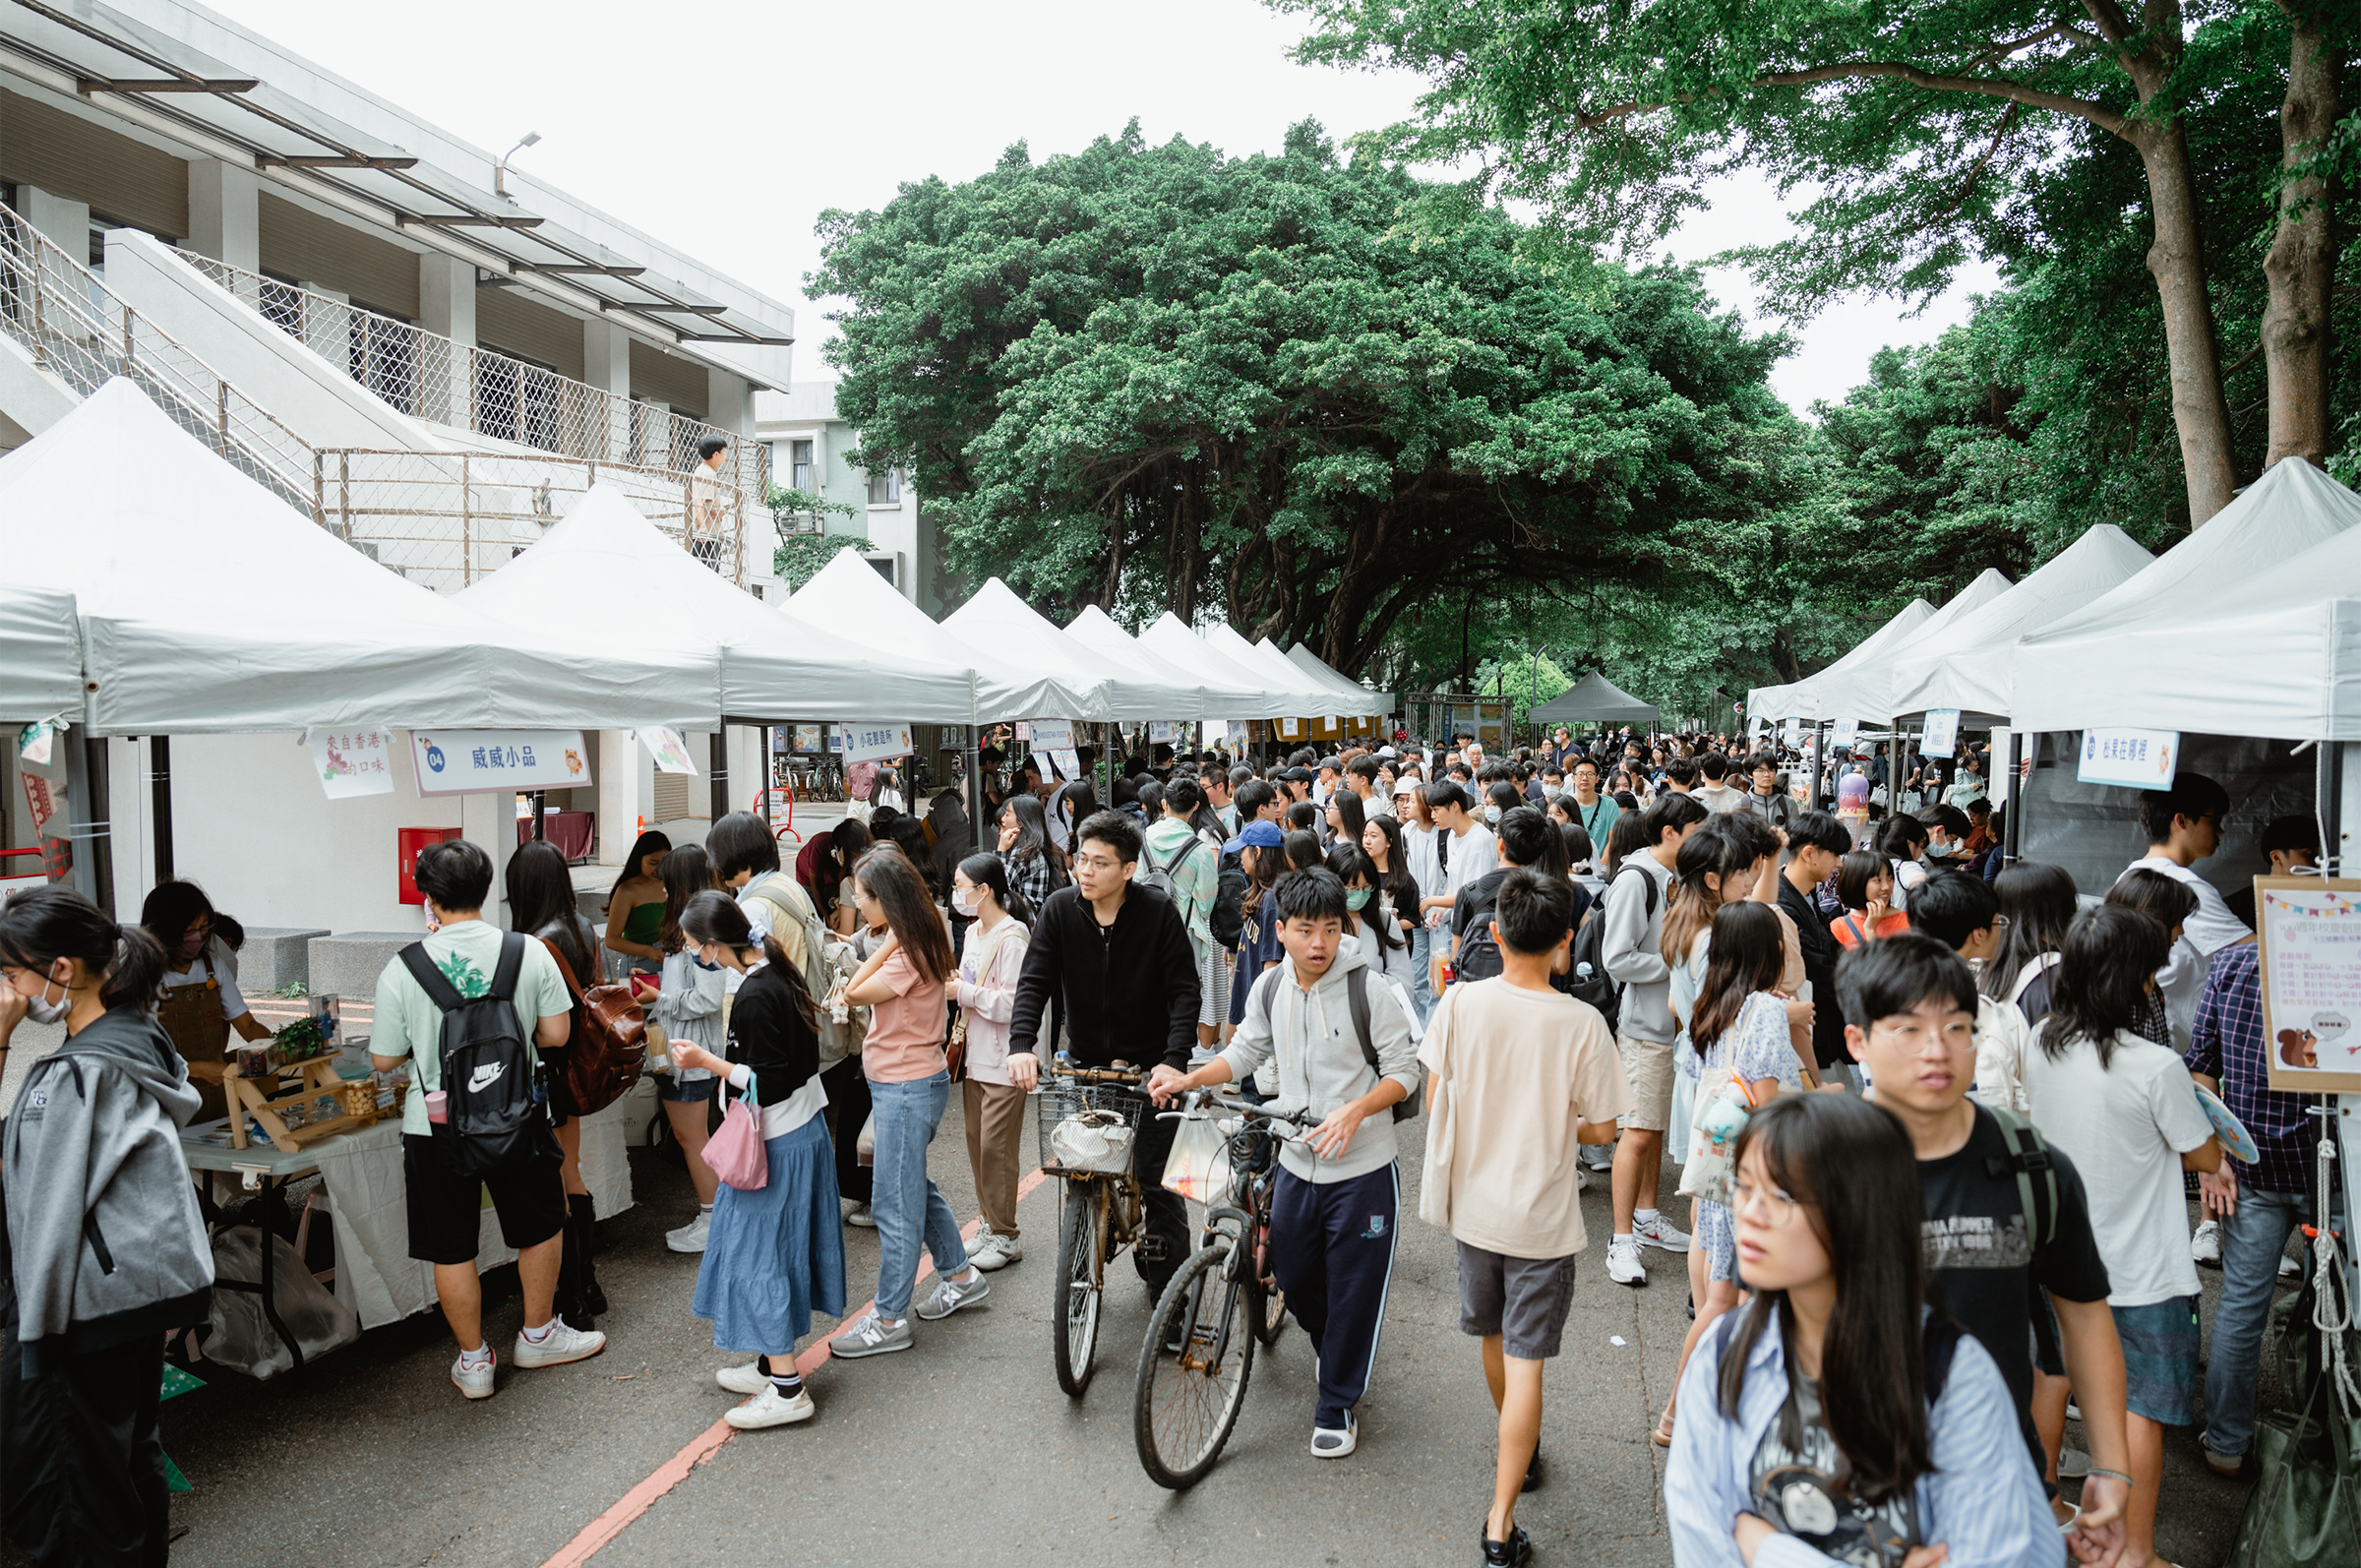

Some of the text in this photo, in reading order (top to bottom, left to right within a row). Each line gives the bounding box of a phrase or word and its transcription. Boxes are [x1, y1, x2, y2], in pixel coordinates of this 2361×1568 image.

[327, 731, 381, 752] 來自香港
[860, 729, 893, 748] 小花製造所
[429, 753, 444, 766] 04
[472, 746, 536, 769] 威威小品
[2102, 738, 2148, 761] 松果在哪裡
[346, 756, 385, 776] 的口味
[473, 1060, 501, 1081] NIKE
